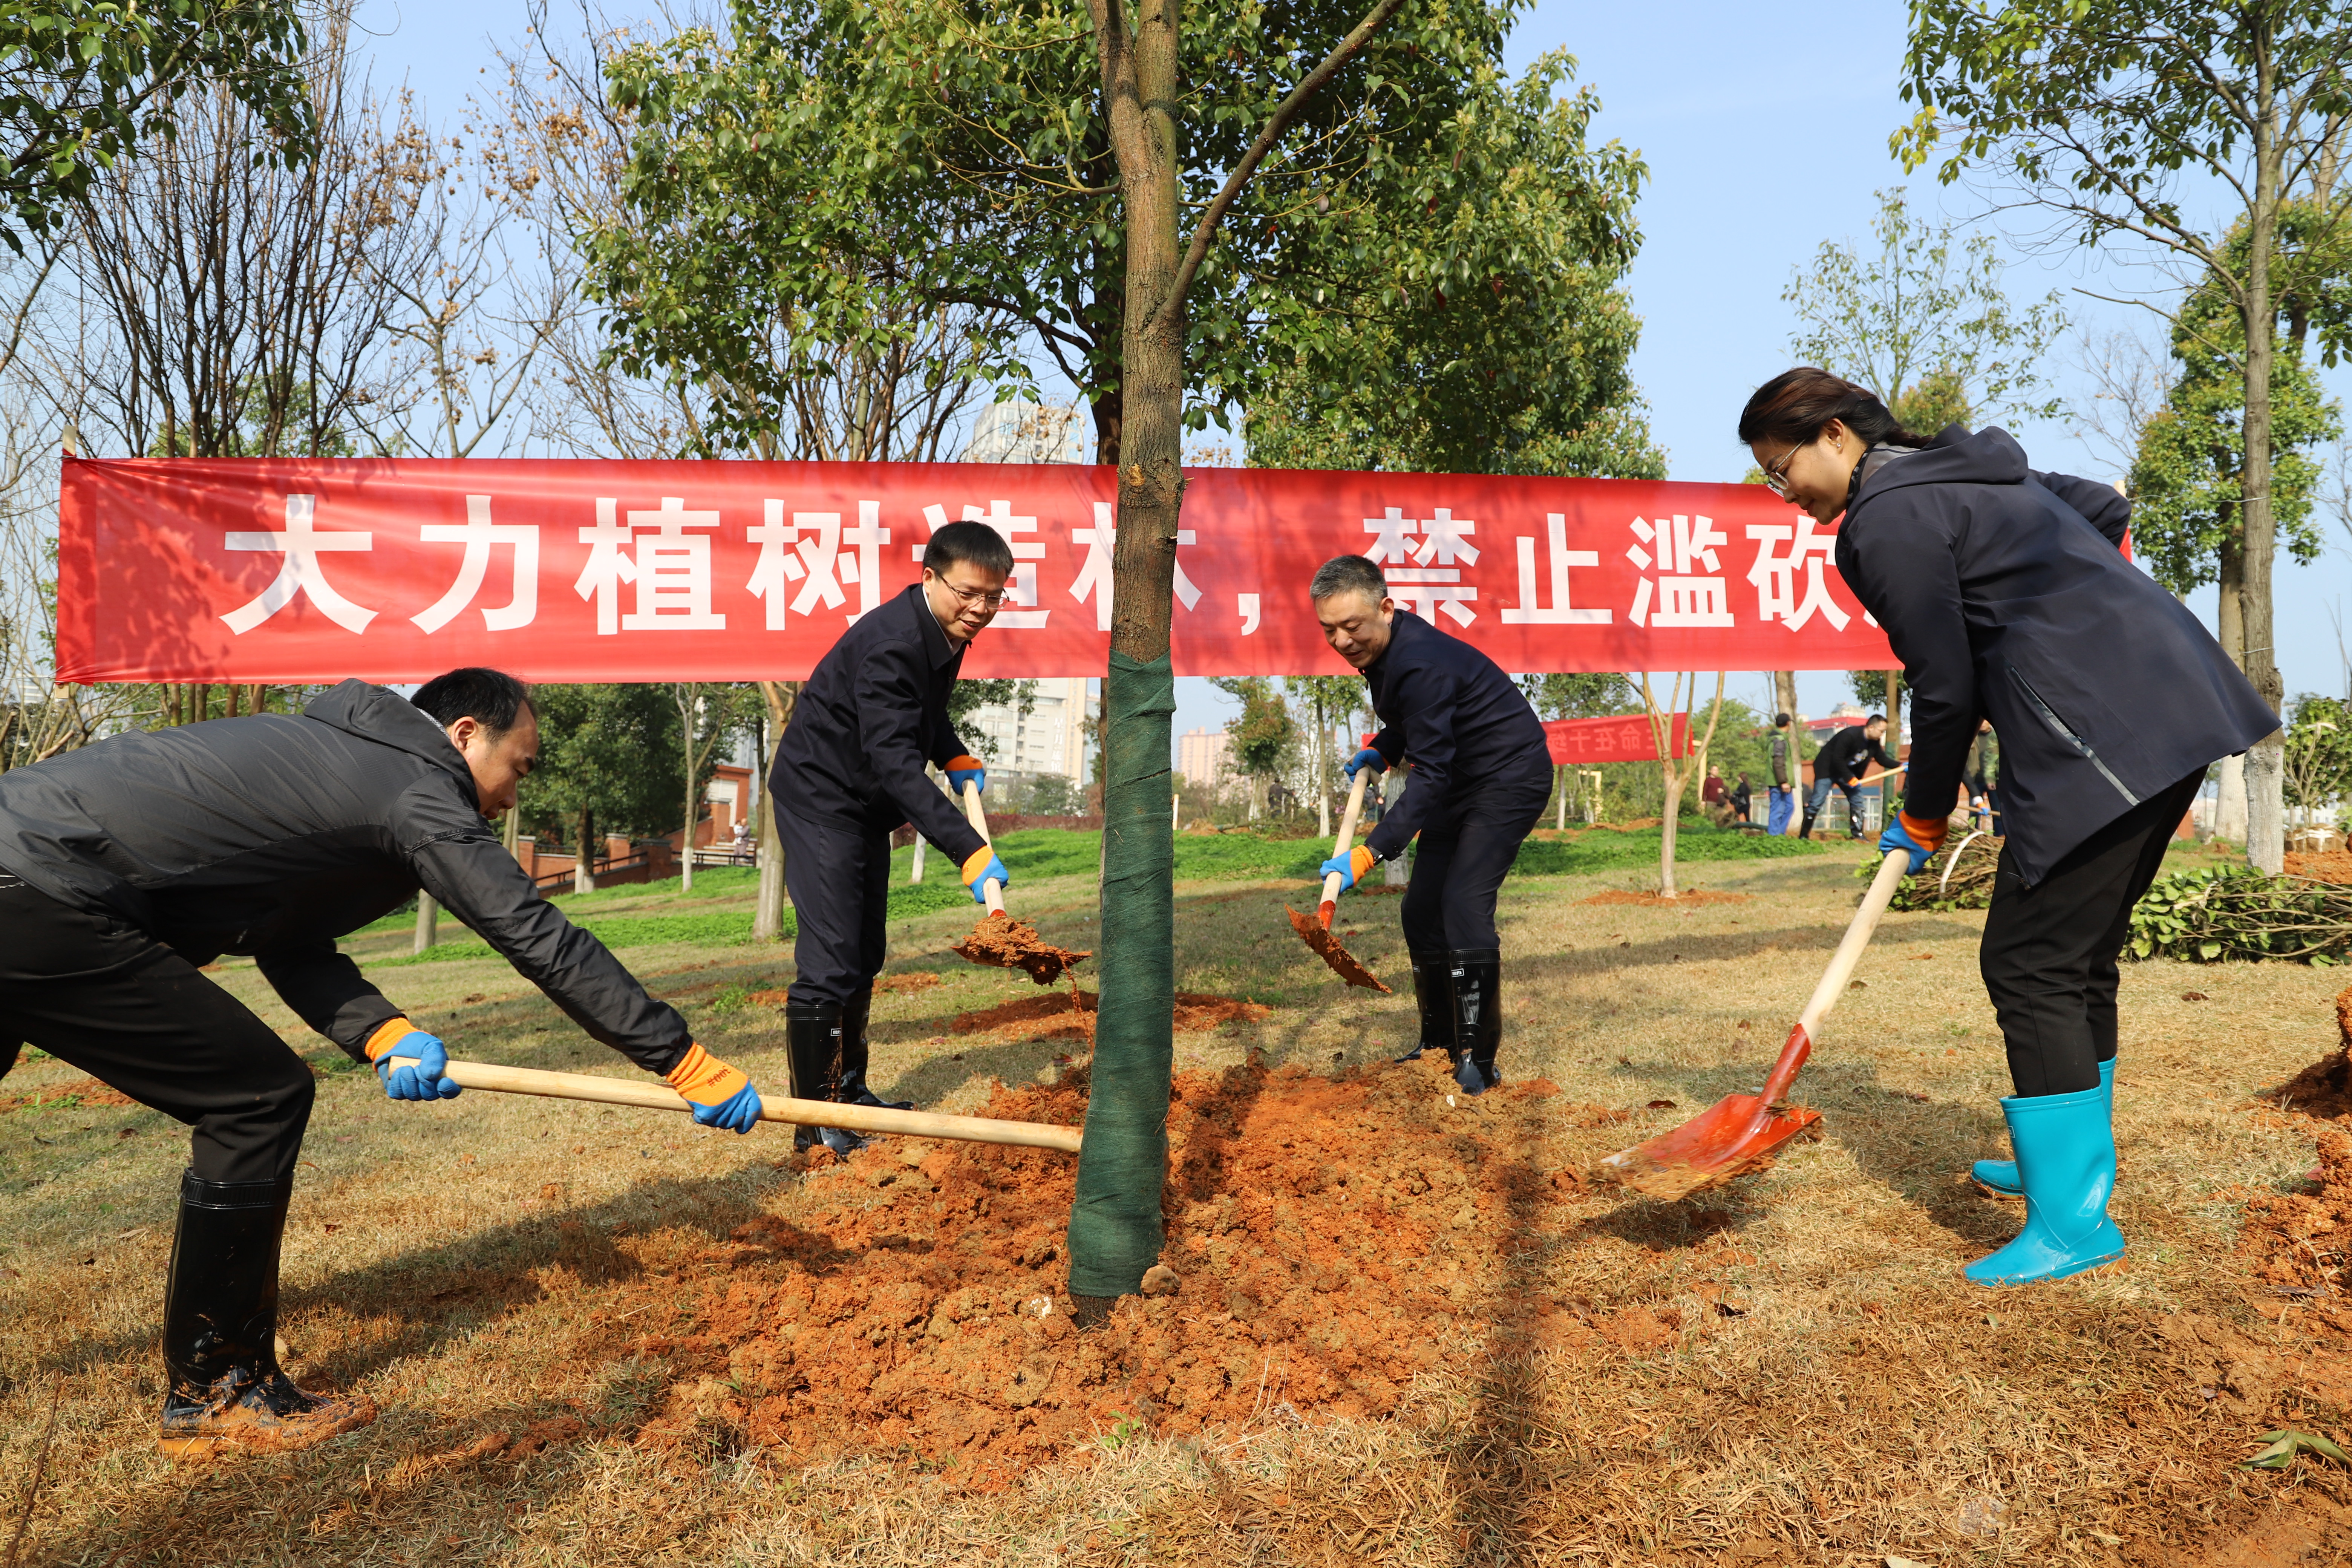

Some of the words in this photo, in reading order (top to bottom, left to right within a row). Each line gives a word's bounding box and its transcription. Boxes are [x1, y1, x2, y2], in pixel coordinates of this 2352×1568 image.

[221, 494, 1879, 635] 大力植树造林，禁止滥砍
